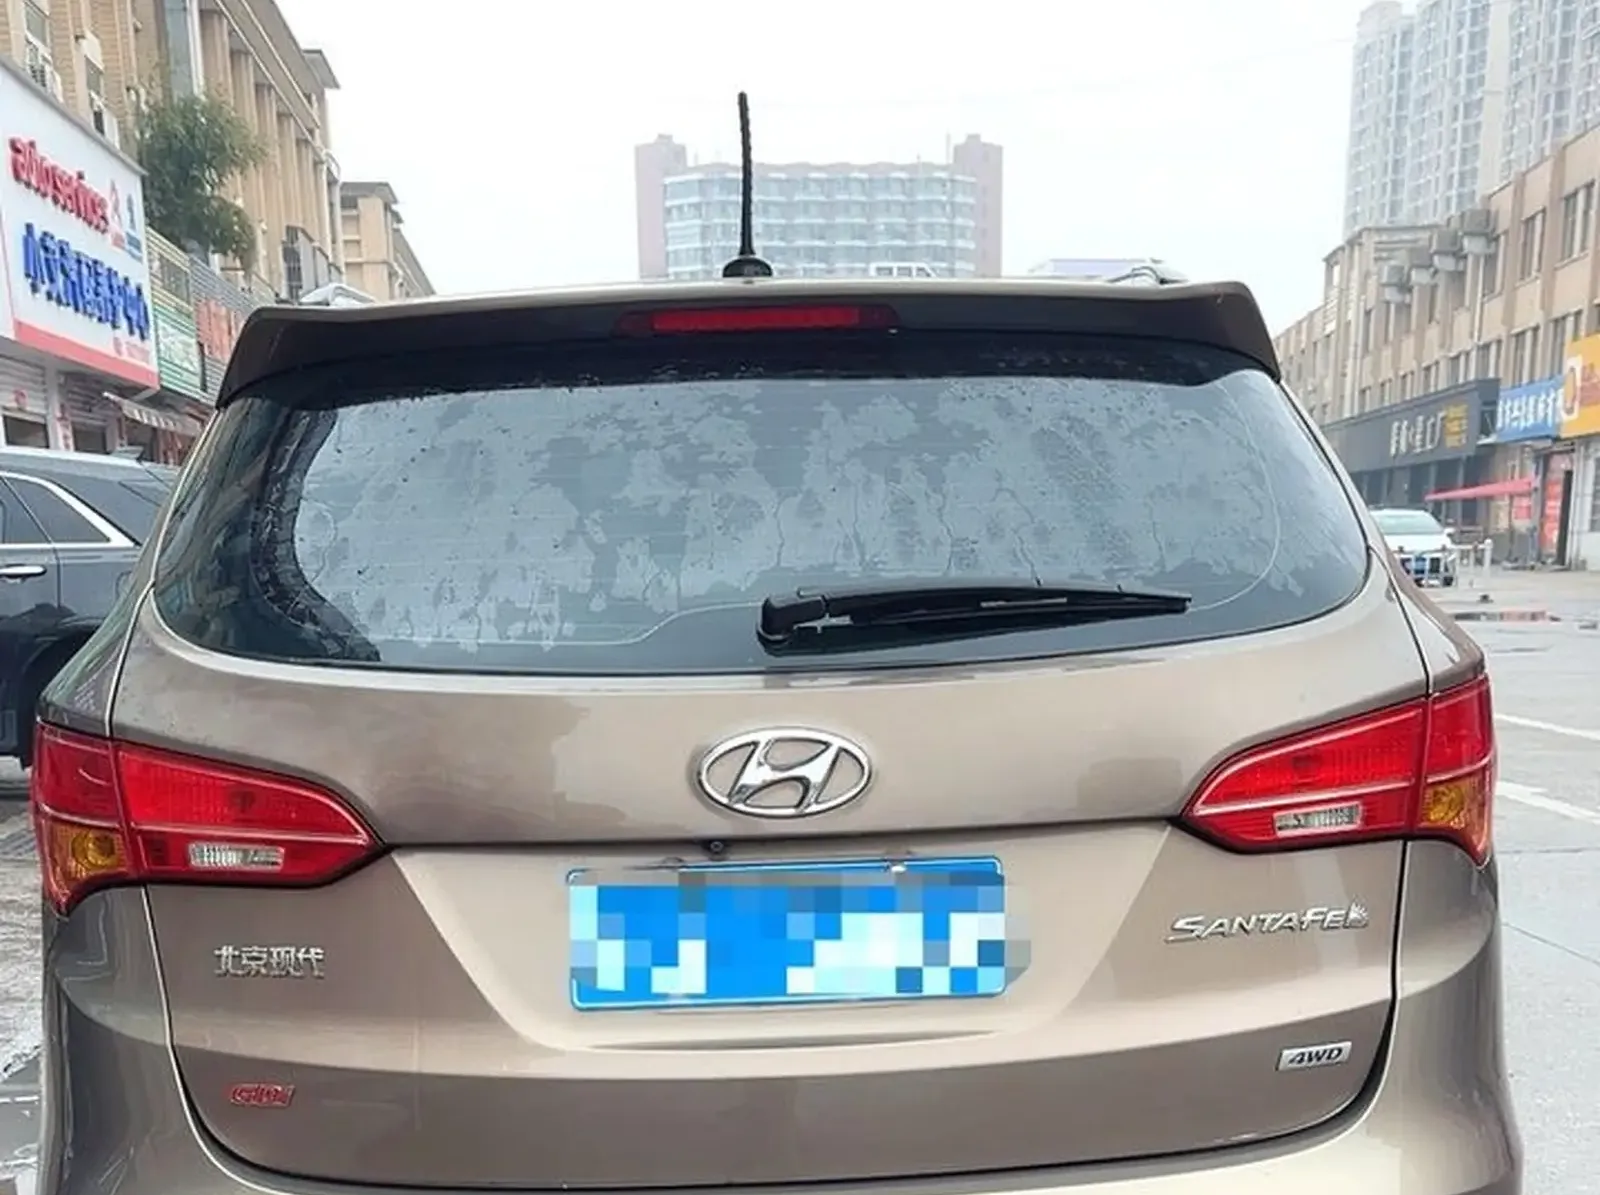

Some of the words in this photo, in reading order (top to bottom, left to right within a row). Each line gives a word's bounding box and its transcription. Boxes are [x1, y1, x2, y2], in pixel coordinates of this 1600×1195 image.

[213, 945, 325, 977] 北京现代
[1288, 1045, 1344, 1066] 4WD
